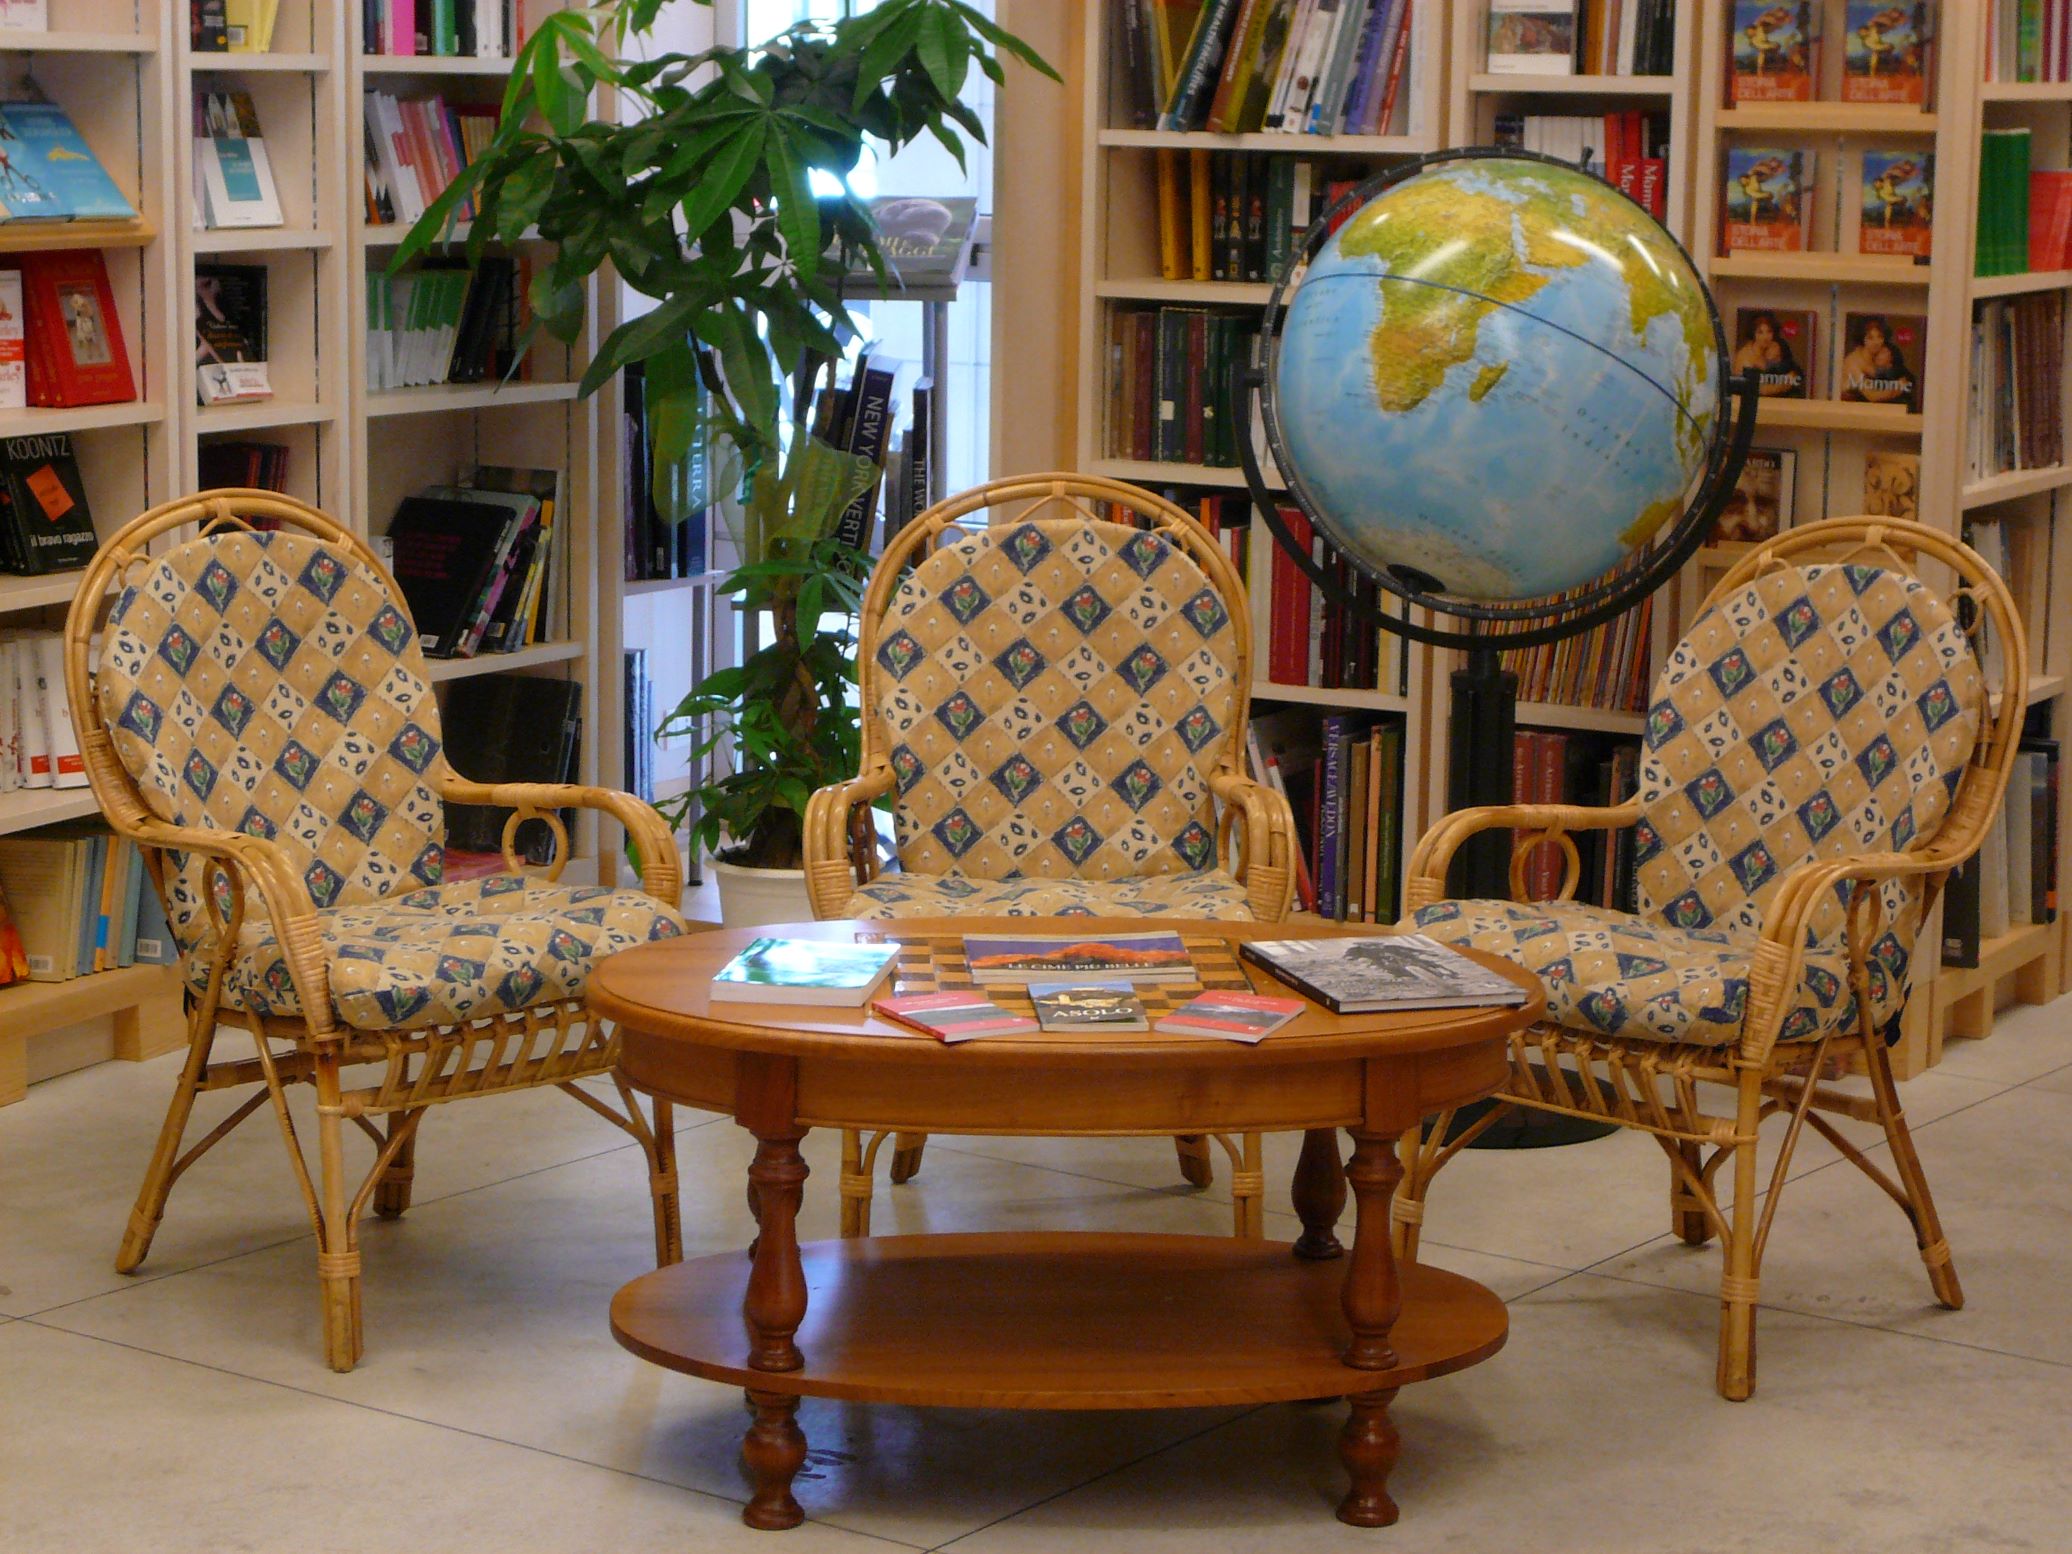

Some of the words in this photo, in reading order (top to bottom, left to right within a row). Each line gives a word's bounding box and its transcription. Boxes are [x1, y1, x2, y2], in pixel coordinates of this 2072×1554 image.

[1759, 373, 1802, 387] amme
[1848, 373, 1913, 392] Mamme
[861, 396, 884, 440] NEW
[7, 435, 70, 460] KOONTZ
[851, 446, 874, 494] YORK
[913, 459, 927, 485] THE
[62, 532, 94, 546] ragazzo
[1031, 962, 1067, 970] CIME
[1052, 1007, 1133, 1018] ASOLO
